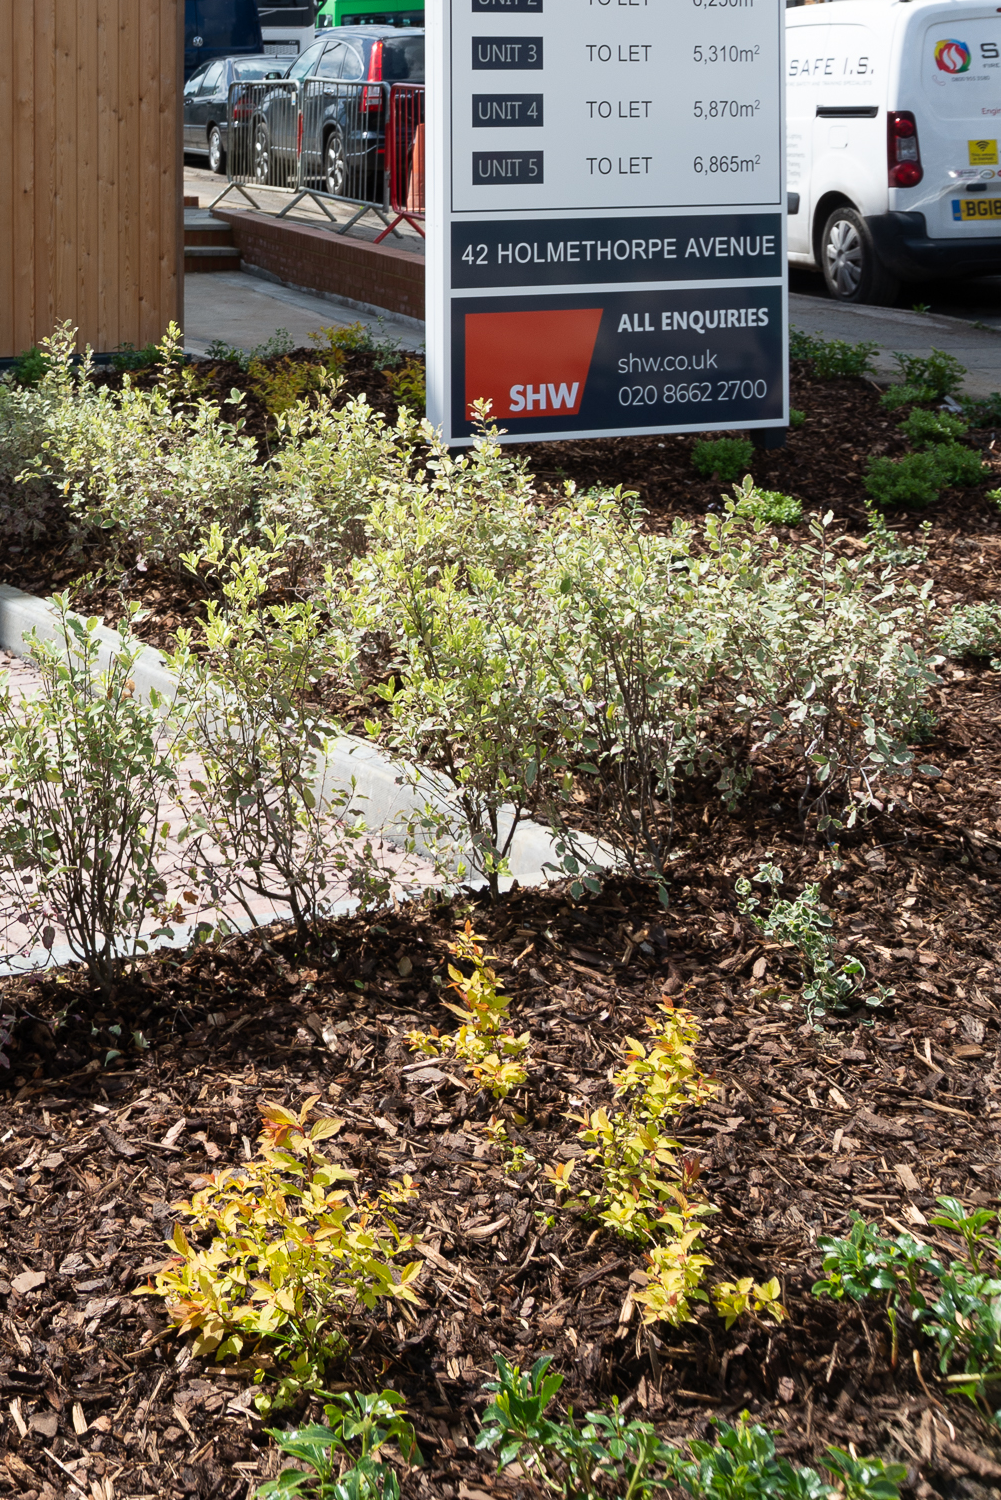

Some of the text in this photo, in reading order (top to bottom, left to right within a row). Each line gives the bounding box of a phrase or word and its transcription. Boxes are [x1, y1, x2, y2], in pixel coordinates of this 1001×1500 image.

[478, 44, 522, 62] UNIT
[527, 45, 537, 62] 3
[585, 45, 612, 62] TO
[617, 45, 652, 62] LET
[789, 57, 874, 76] SAFE I.S.
[478, 101, 522, 119] UNIT
[527, 102, 538, 119] 4
[585, 101, 612, 118] TO
[617, 101, 652, 118] LET
[478, 159, 522, 177] UNIT
[528, 160, 538, 177] 5
[585, 157, 612, 174] TO
[617, 157, 652, 174] LET
[462, 235, 775, 264] 42 HOLMETHORPE AVENUE
[617, 307, 769, 334] ALL ENQUIRIES
[617, 349, 718, 373] shw.co.uk
[509, 382, 579, 412] SHW
[618, 379, 767, 405] 020 8662 2700
